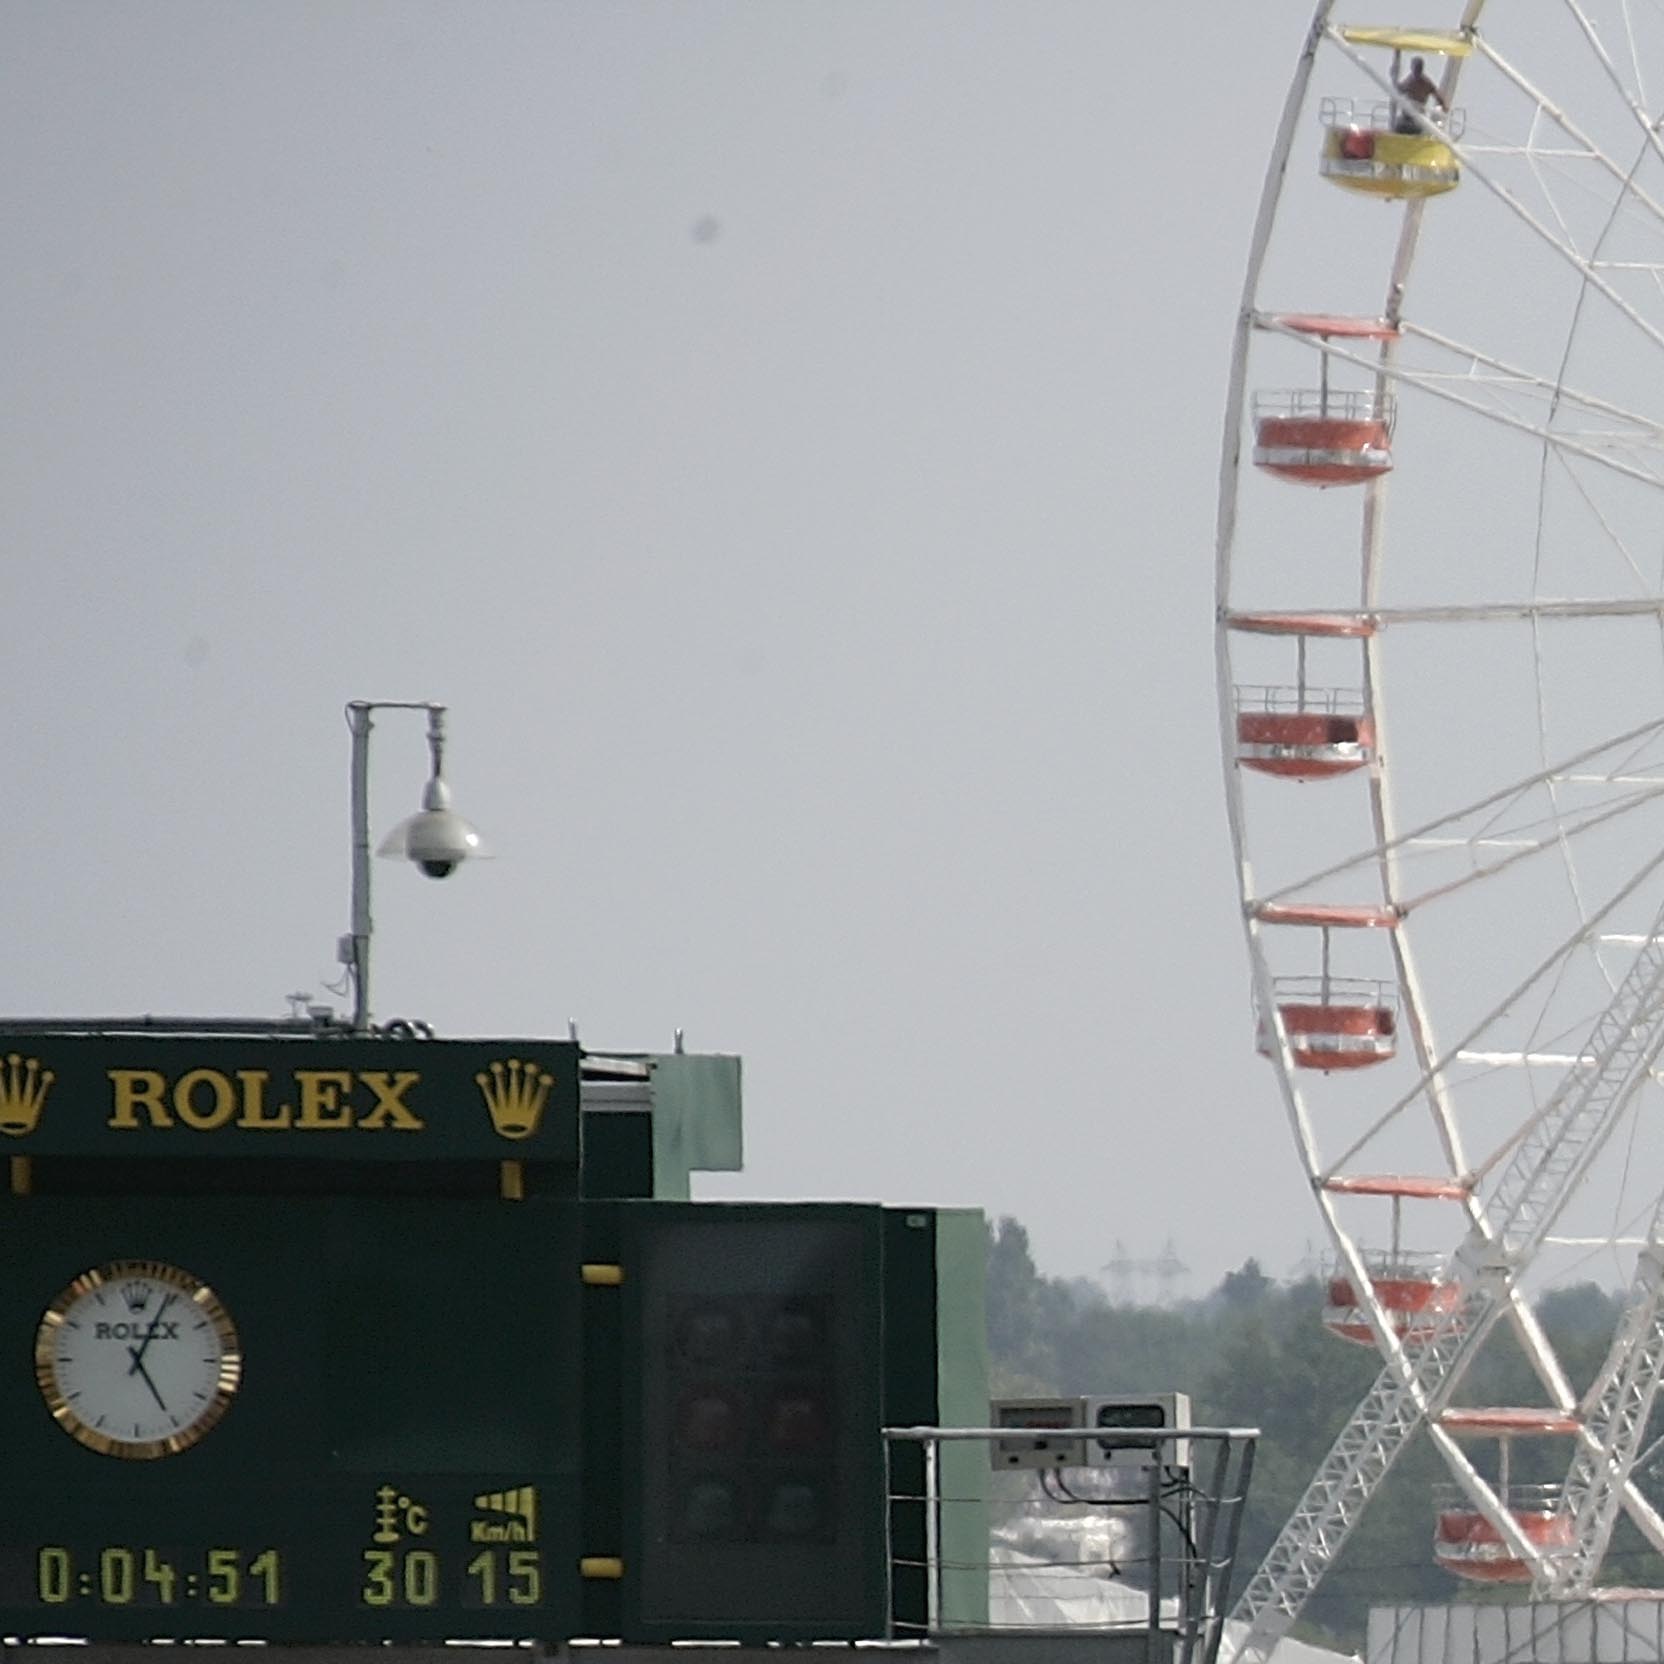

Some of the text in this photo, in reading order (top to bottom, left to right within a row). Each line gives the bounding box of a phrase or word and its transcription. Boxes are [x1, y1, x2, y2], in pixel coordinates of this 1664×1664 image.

[108, 1069, 423, 1131] ROLEX
[95, 1322, 181, 1340] ROLEX
[471, 1519, 526, 1543] Km/h
[40, 1548, 540, 1605] 0:04:51 30 15
